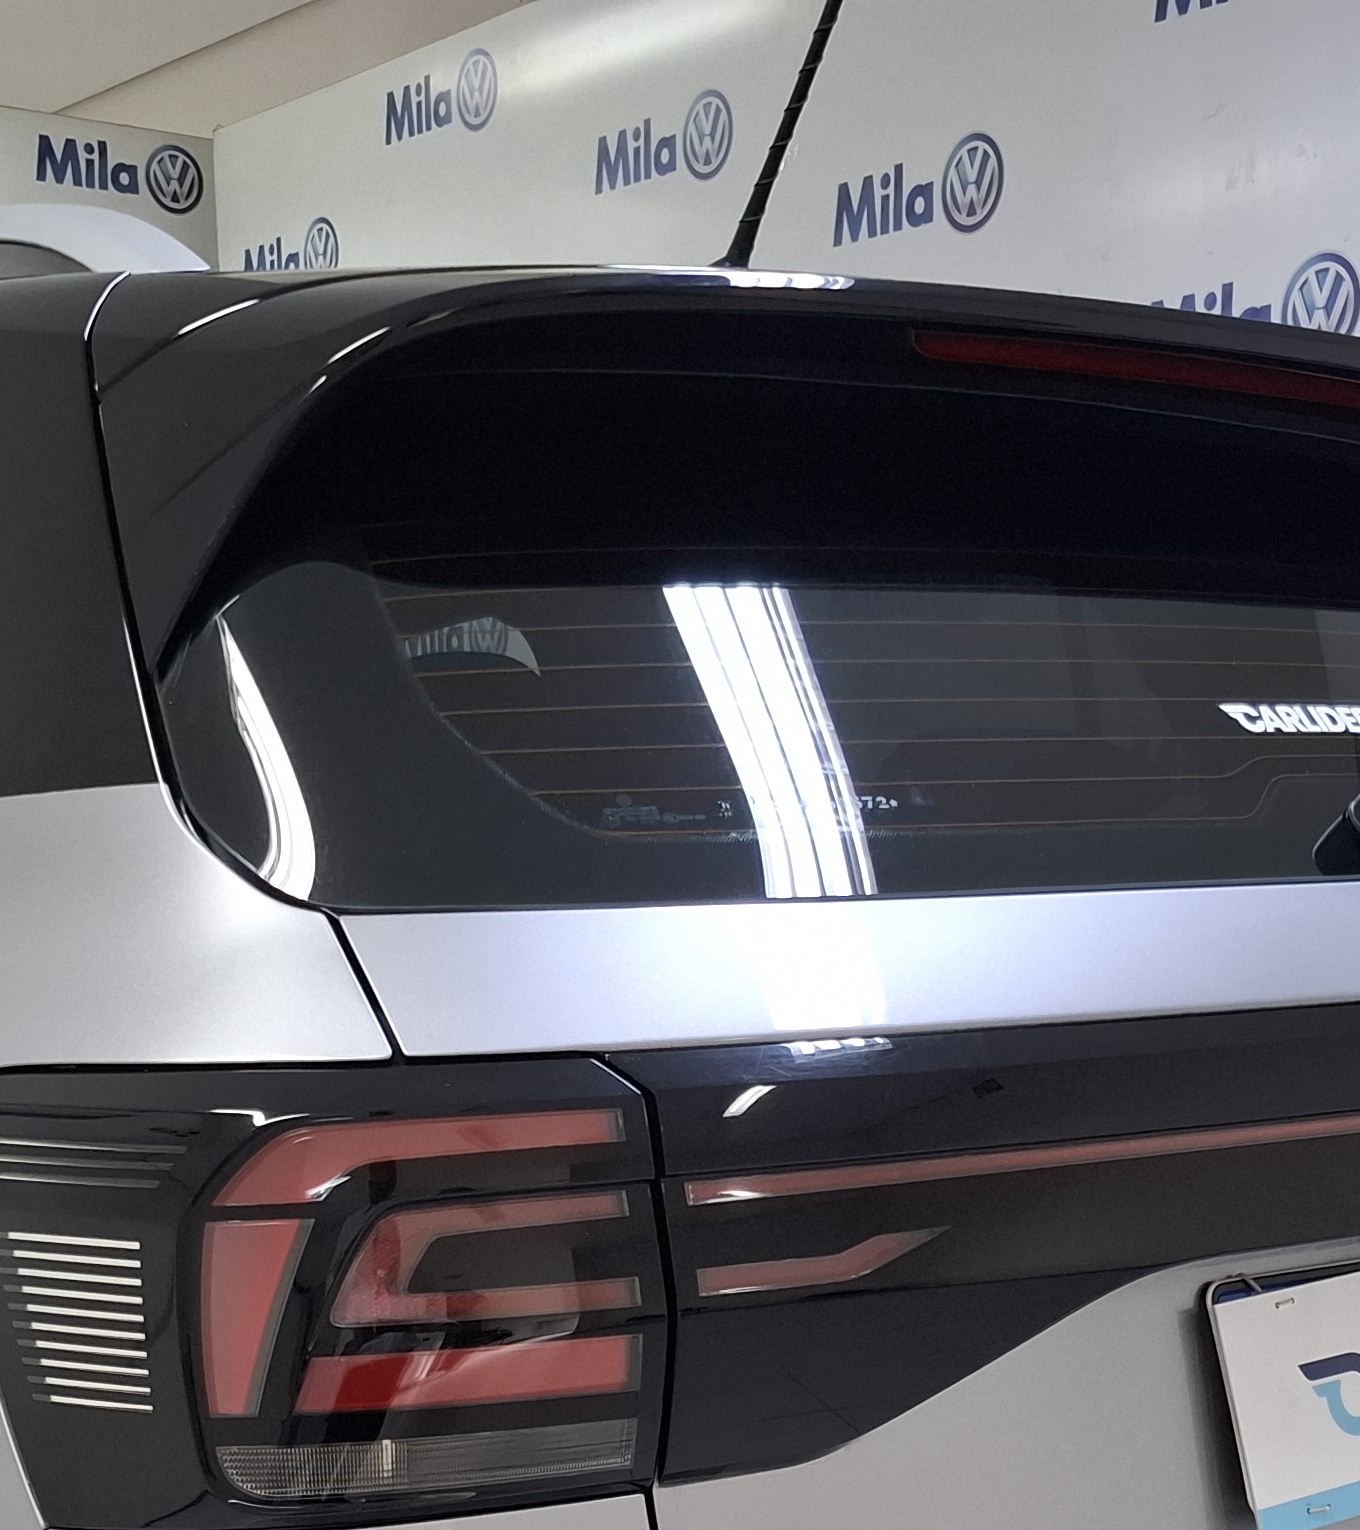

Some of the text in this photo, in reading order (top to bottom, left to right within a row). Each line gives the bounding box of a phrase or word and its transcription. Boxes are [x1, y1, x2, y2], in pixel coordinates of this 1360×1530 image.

[386, 75, 451, 145] Mila
[36, 134, 139, 195] Mila
[595, 118, 676, 194] Mila
[834, 163, 933, 247] Mila
